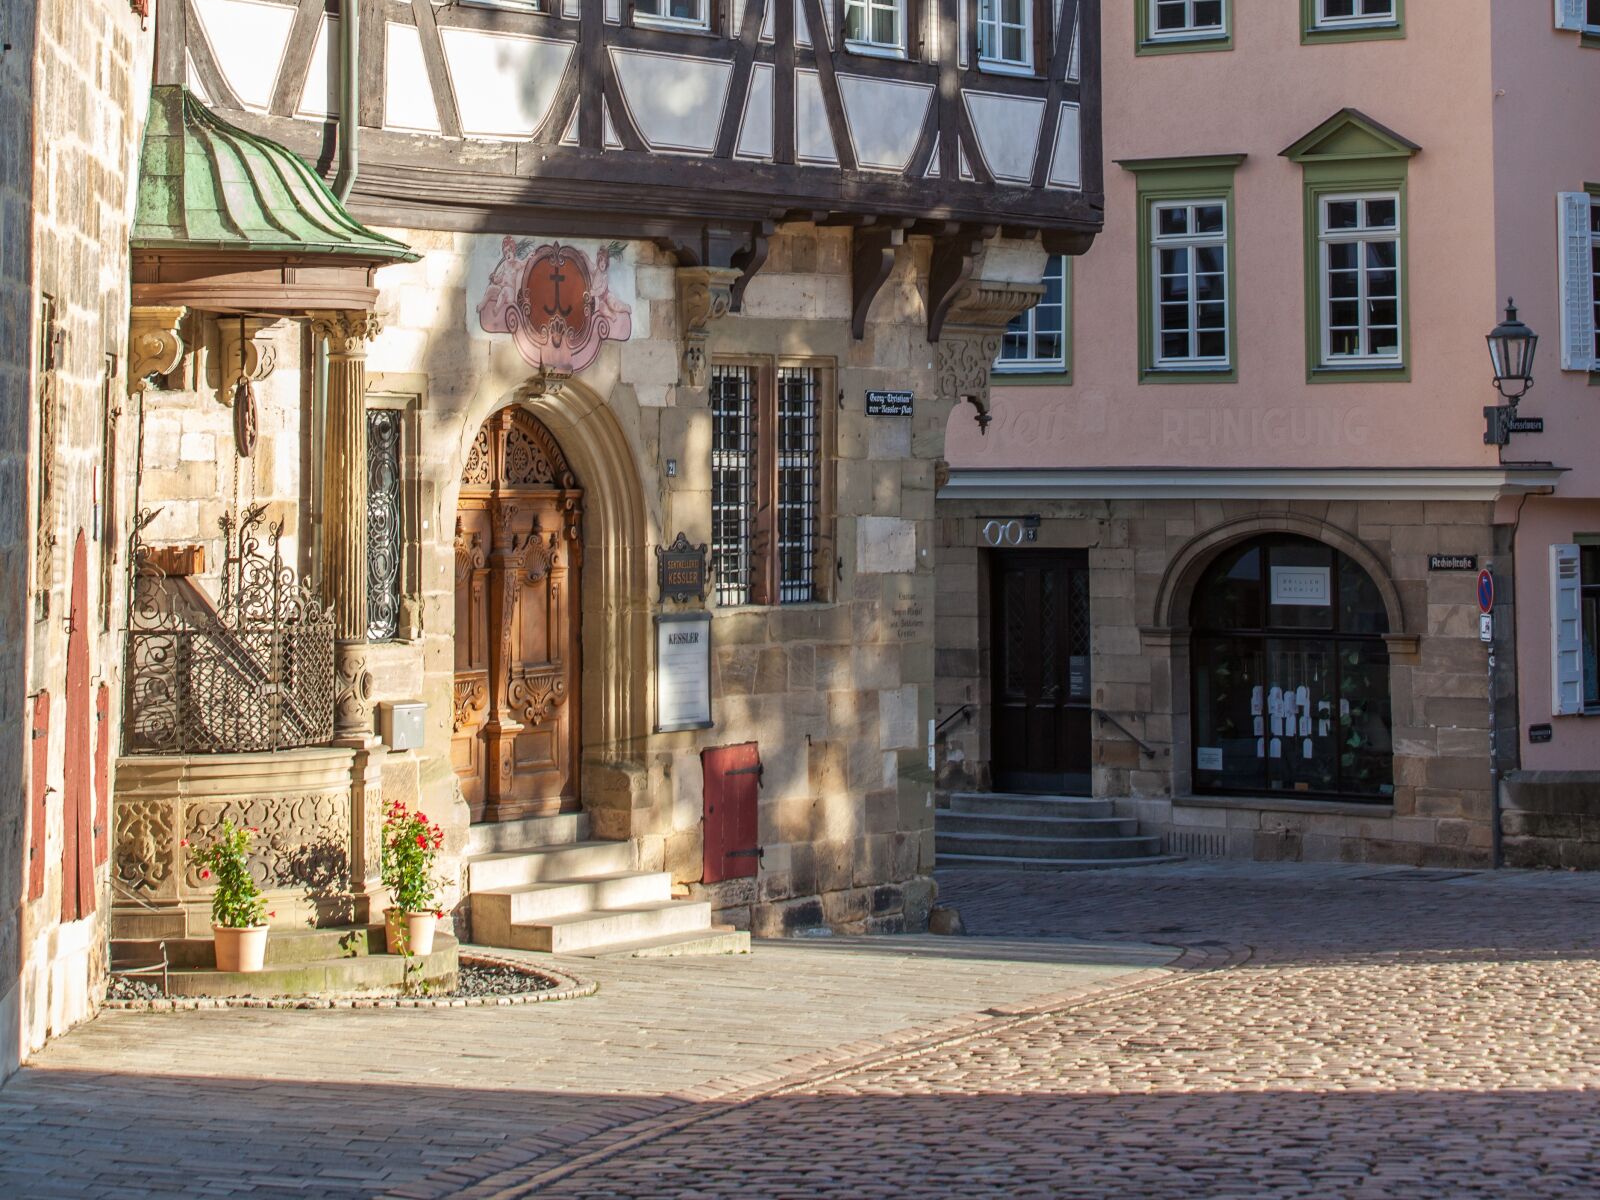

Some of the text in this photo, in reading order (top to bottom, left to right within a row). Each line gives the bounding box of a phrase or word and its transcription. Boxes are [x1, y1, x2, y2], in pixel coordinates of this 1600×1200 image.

[1160, 406, 1369, 447] REINIGUNG
[1432, 557, 1472, 569] Archivstraße
[669, 572, 698, 584] KESSLER
[669, 632, 699, 644] KESSLER
